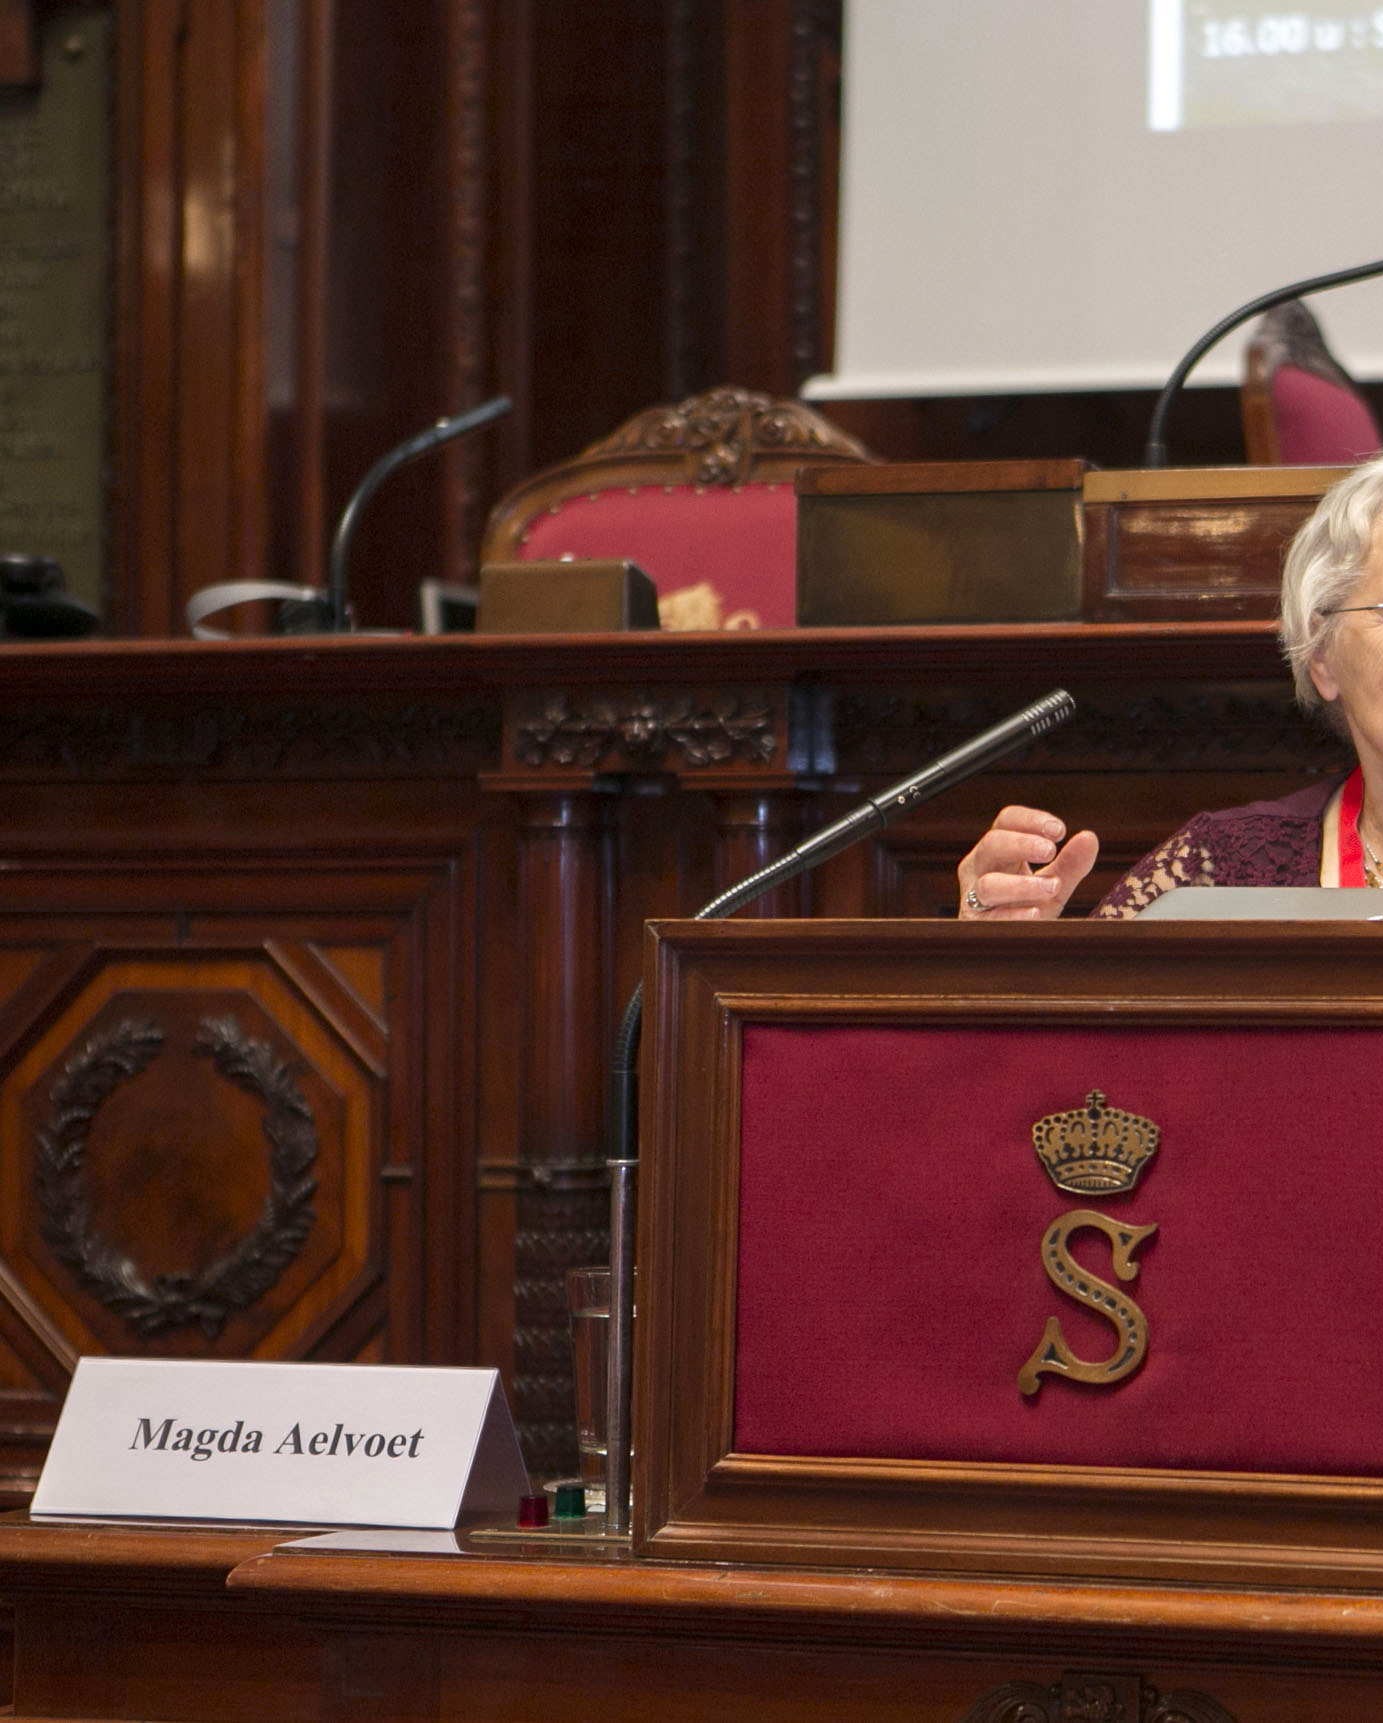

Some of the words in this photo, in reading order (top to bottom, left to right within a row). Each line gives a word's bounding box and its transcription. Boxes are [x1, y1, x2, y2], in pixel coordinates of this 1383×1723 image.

[1202, 14, 1310, 58] 16.00
[1313, 21, 1345, 51] u
[1018, 1208, 1159, 1396] S
[128, 1417, 263, 1461] Magda
[273, 1421, 425, 1458] Aelvoet
